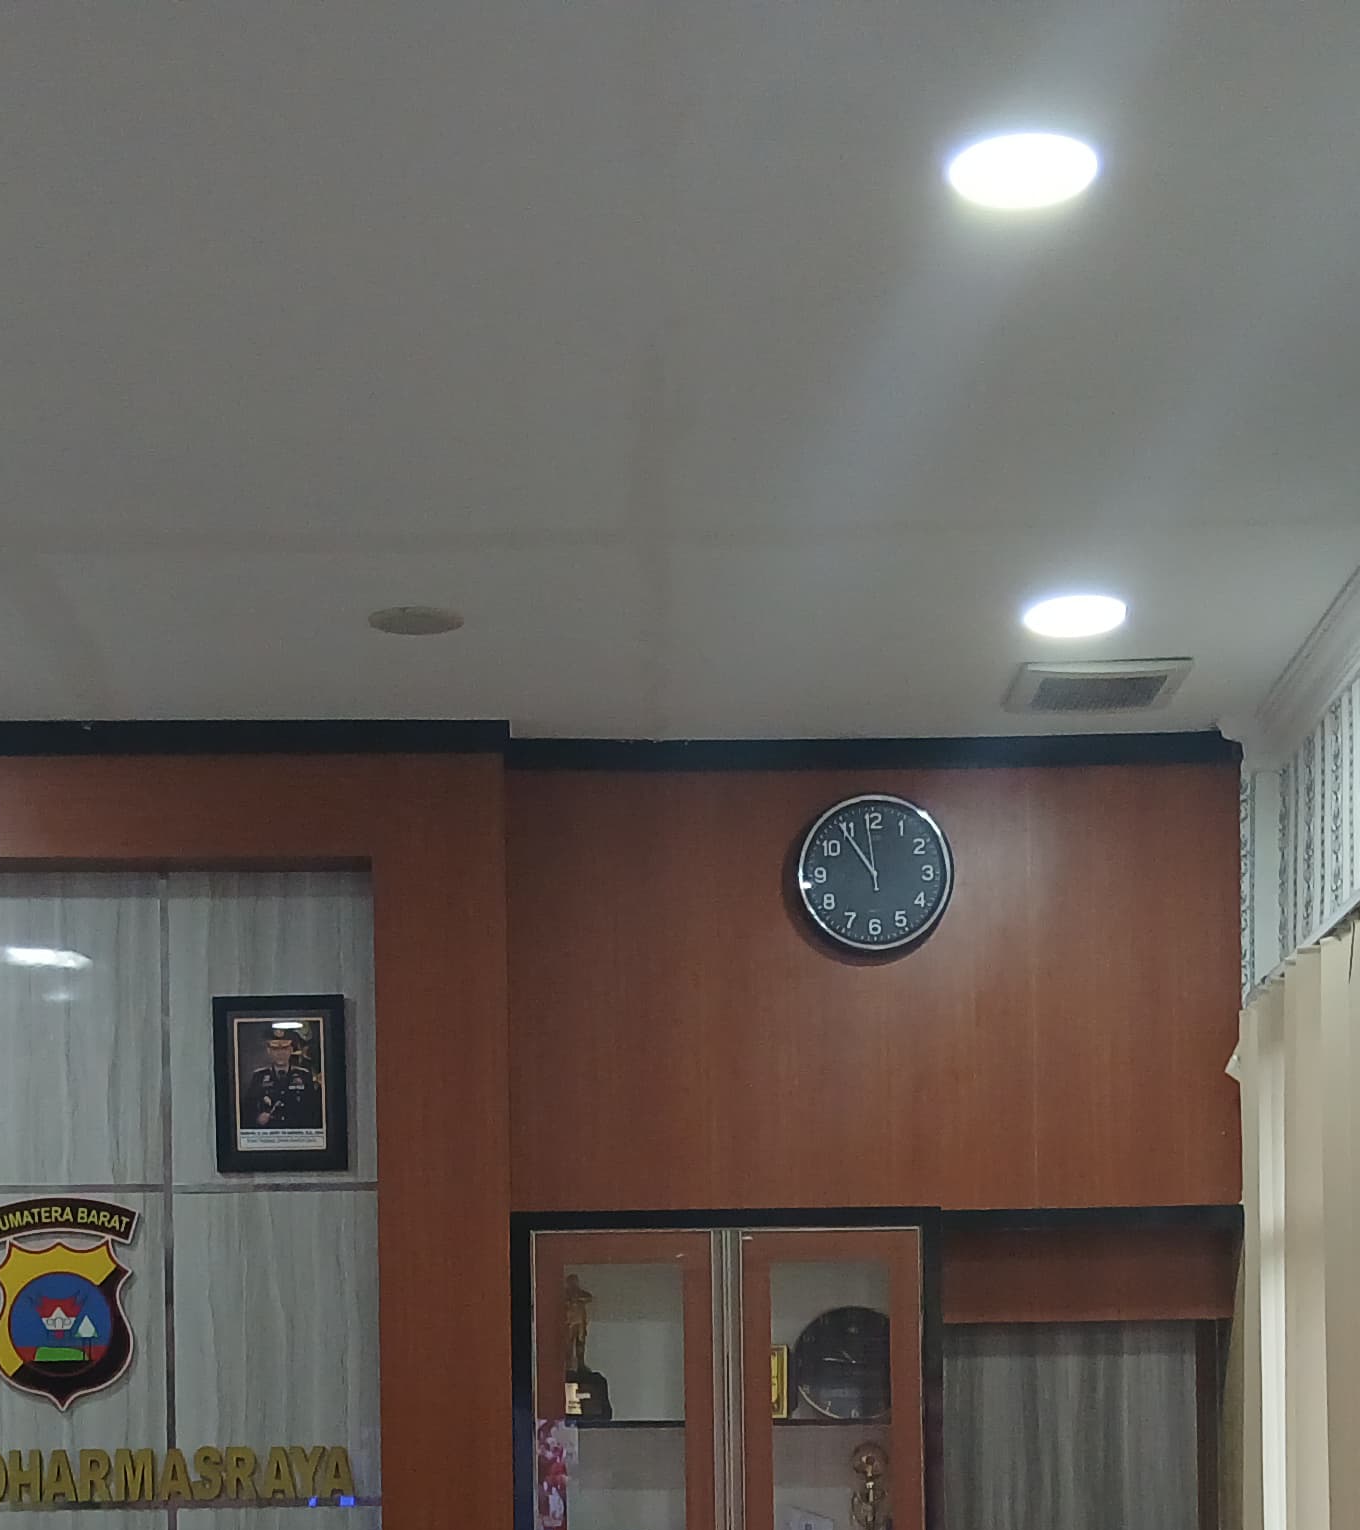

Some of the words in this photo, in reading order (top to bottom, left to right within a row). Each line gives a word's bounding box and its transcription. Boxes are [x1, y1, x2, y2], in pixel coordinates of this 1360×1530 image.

[898, 820, 904, 836] 1
[822, 840, 840, 857] 10
[913, 838, 926, 855] 2
[814, 867, 827, 883] 9
[921, 865, 934, 881] 3
[823, 893, 836, 910] 8
[914, 891, 926, 907] 4
[844, 912, 857, 929] 7
[868, 918, 882, 935] 6
[895, 911, 907, 927] 5
[77, 1207, 130, 1232] BARAT
